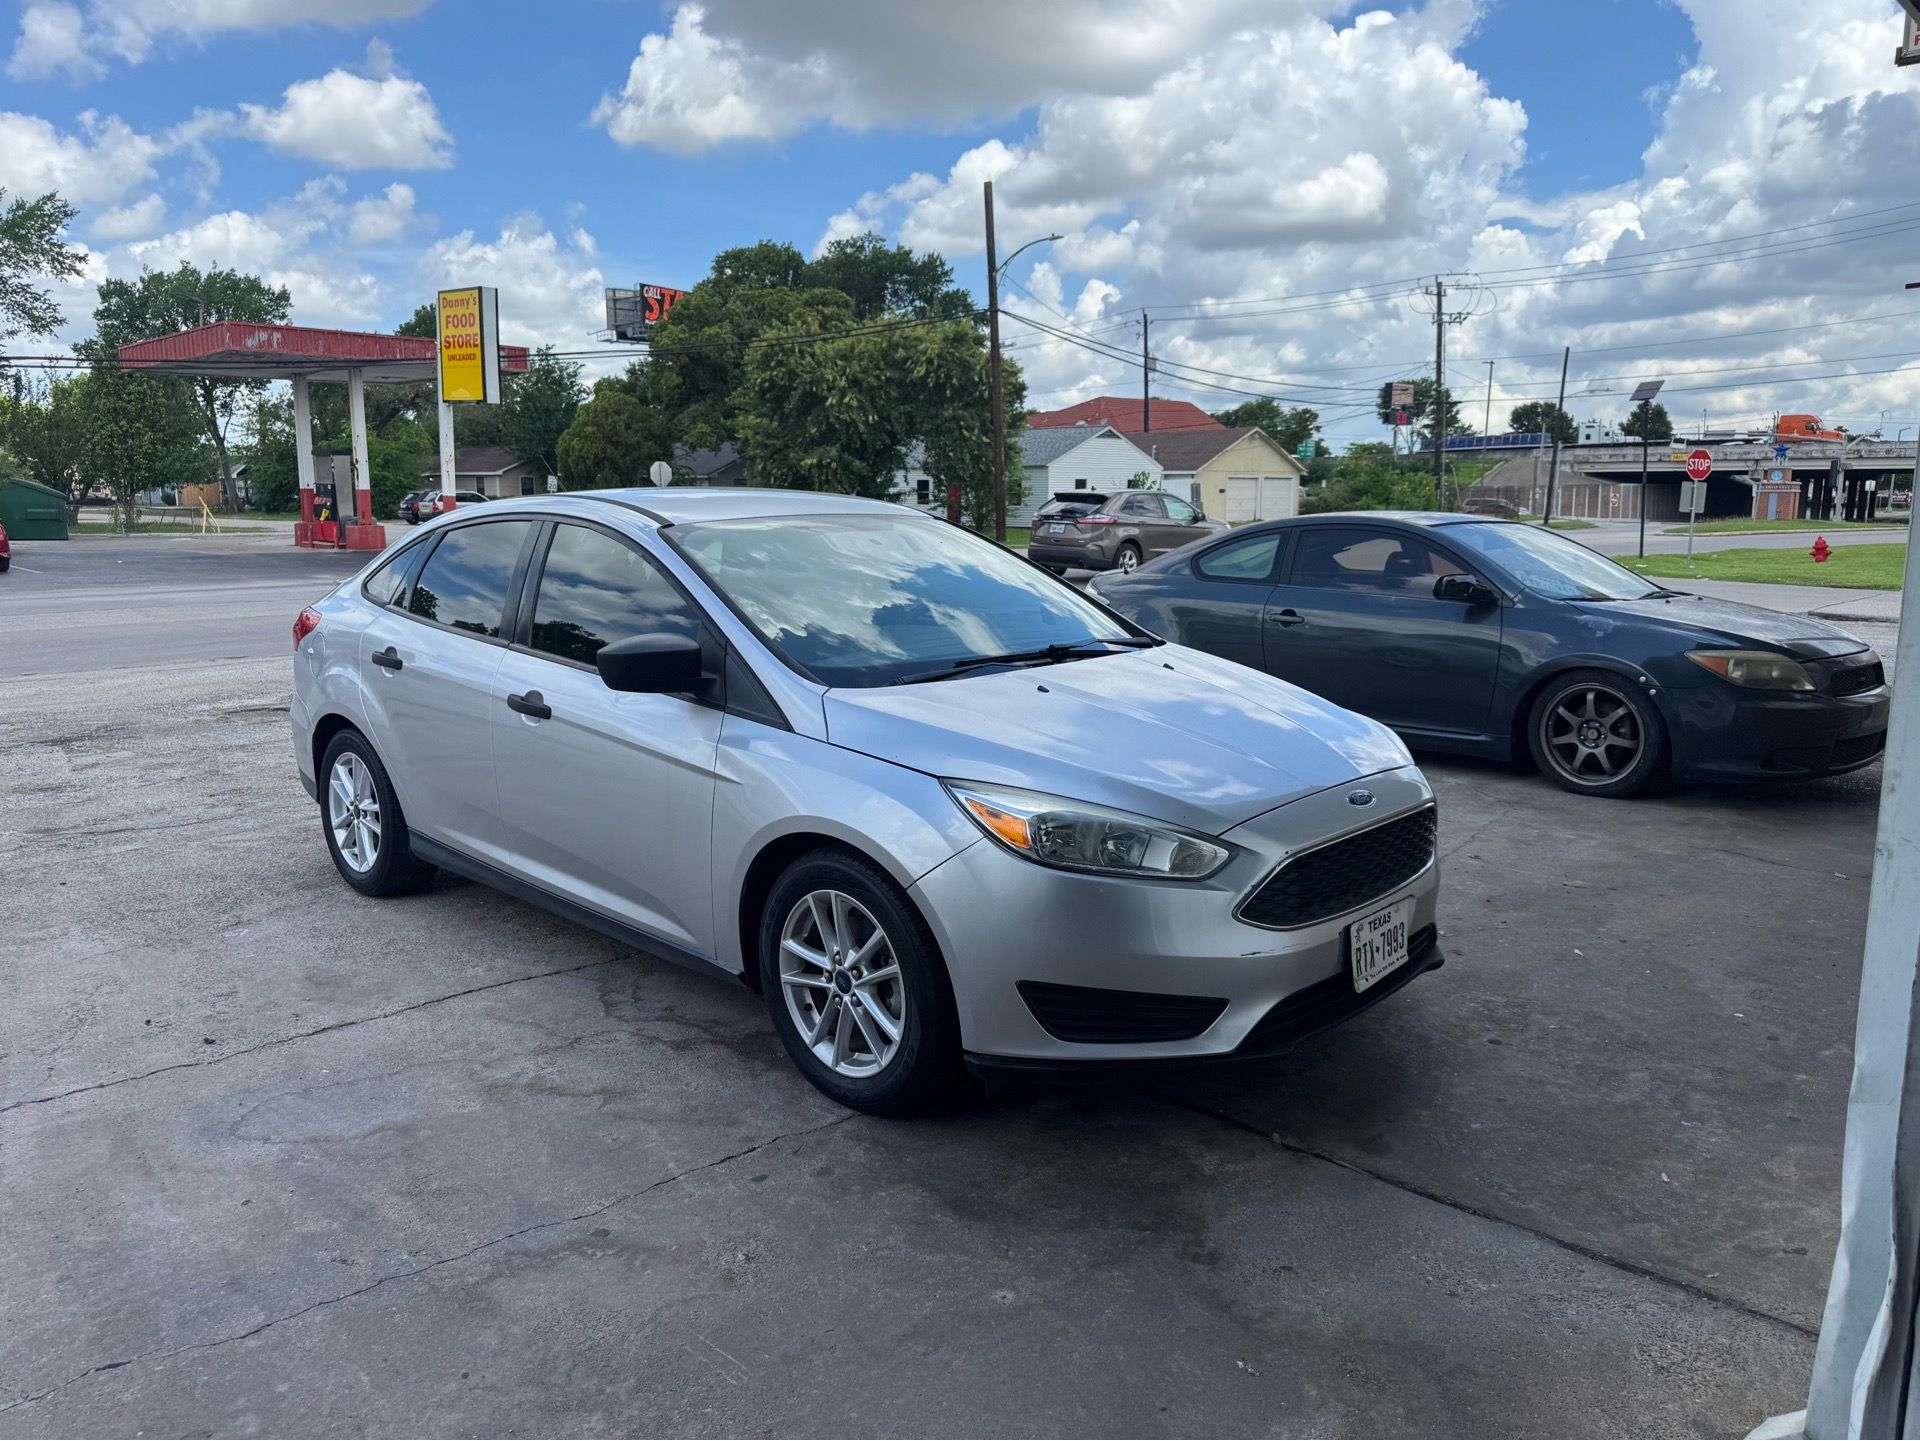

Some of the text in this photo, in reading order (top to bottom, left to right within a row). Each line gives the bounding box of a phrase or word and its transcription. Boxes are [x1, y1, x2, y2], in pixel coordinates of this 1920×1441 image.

[643, 286, 661, 299] CALL
[442, 293, 477, 310] Danny's
[445, 313, 476, 329] FOOD
[444, 333, 479, 349] STORE
[447, 353, 477, 362] UNLEADED
[1688, 458, 1711, 471] STOP
[1368, 911, 1391, 933] TEXAS
